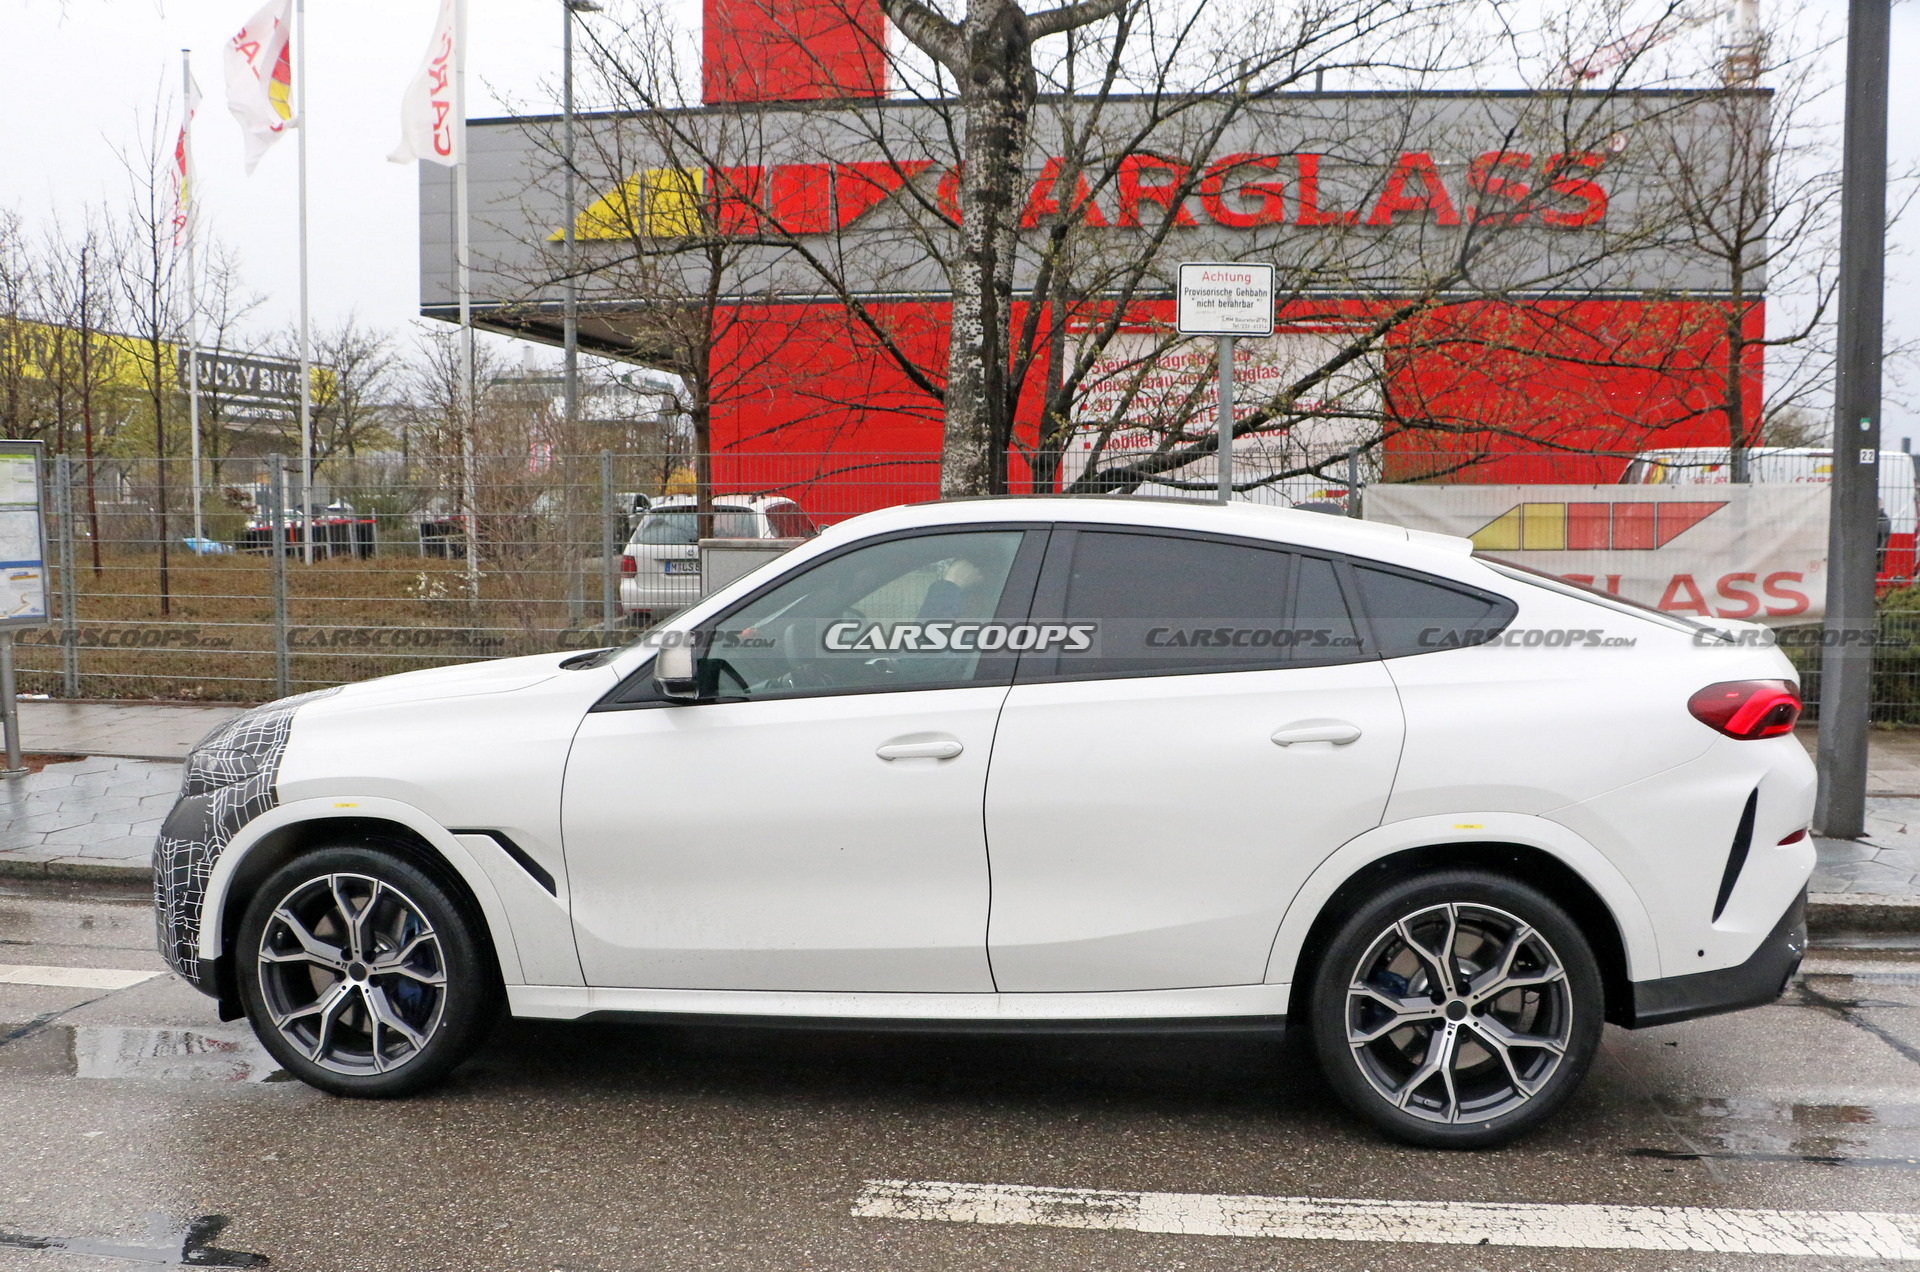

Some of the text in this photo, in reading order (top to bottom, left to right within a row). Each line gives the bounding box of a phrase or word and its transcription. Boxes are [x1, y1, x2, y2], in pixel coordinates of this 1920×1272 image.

[1201, 271, 1252, 284] Achtung
[1184, 287, 1268, 297] Provisorische Gehbahn
[1196, 299, 1254, 309] nicht befahrbar
[1861, 450, 1875, 462] 22
